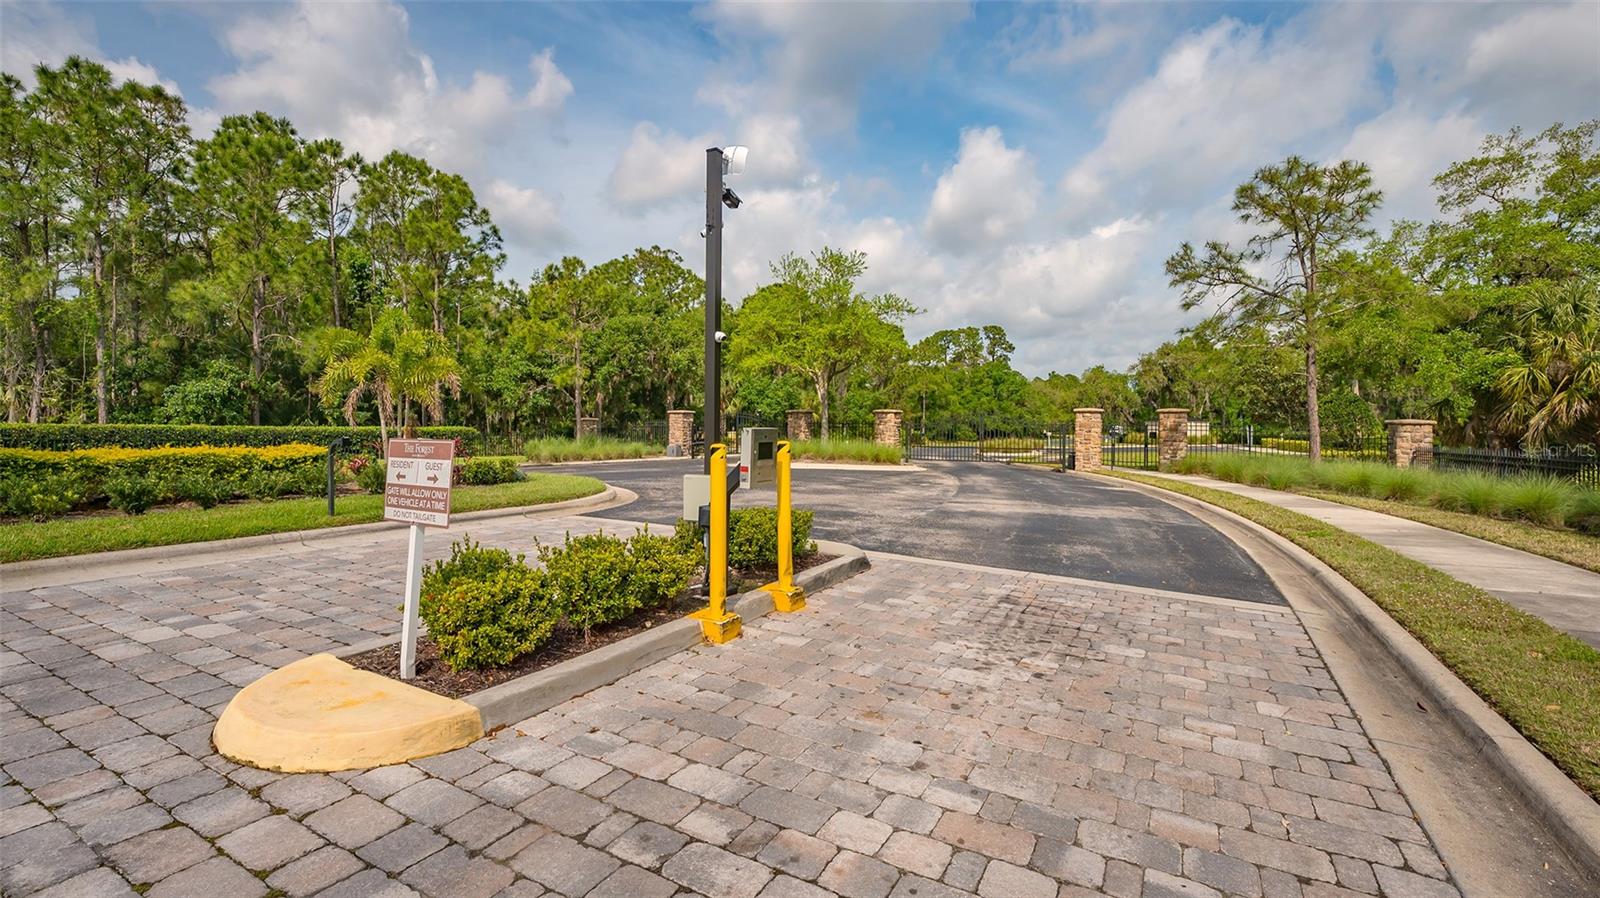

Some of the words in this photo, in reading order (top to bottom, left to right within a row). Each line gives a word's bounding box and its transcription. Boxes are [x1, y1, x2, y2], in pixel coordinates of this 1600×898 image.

[391, 460, 414, 469] RESIDENT
[425, 461, 443, 471] GUEST
[387, 486, 400, 495] GATE
[400, 487, 411, 497] WILL
[411, 488, 431, 498] ALLOW
[431, 490, 448, 500] ONLY
[387, 496, 398, 505] ONE
[398, 497, 419, 508] VEHICLE
[419, 500, 427, 508] AT
[431, 500, 446, 511] TIME
[393, 510, 401, 518] DO
[401, 511, 412, 519] NOT
[412, 512, 436, 522] TAILGATE
